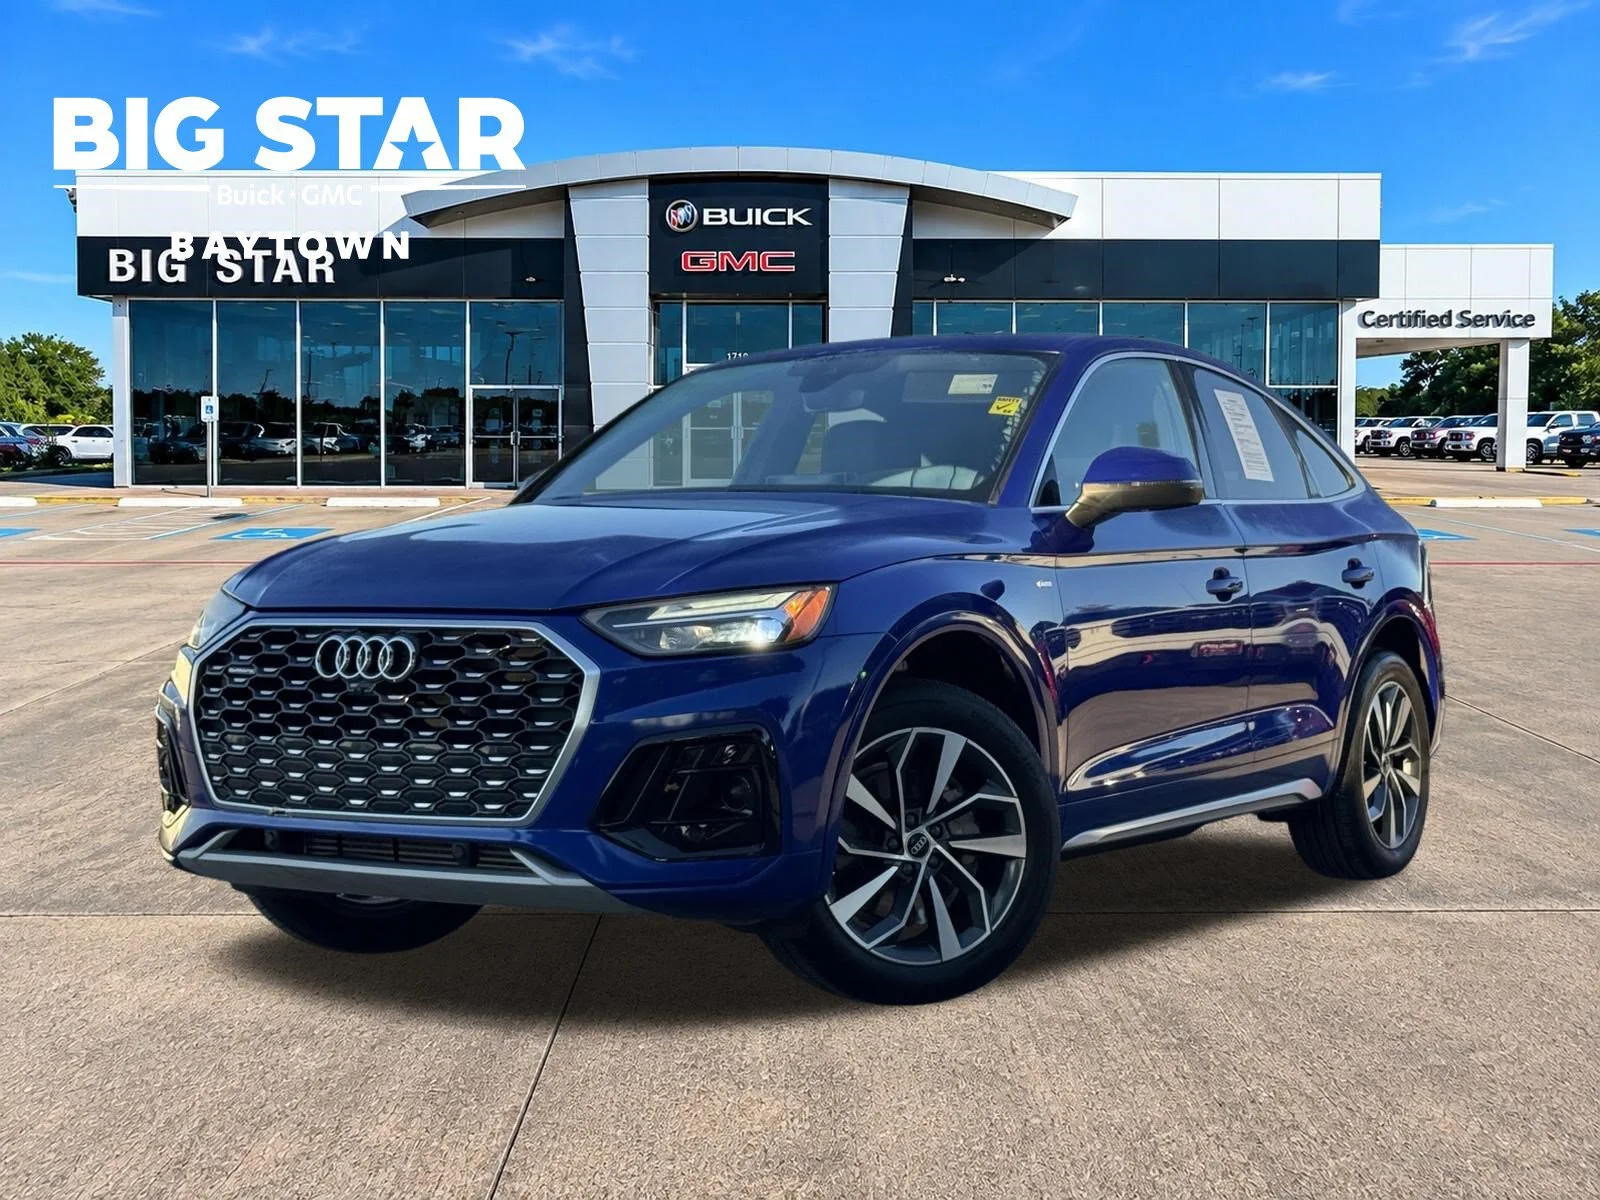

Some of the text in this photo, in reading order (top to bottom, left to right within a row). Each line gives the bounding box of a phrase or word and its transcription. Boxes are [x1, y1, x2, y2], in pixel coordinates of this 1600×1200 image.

[703, 208, 812, 226] BUICK
[109, 249, 336, 283] BIG STAR
[682, 251, 795, 271] GMC
[1360, 310, 1535, 328] Certified Service
